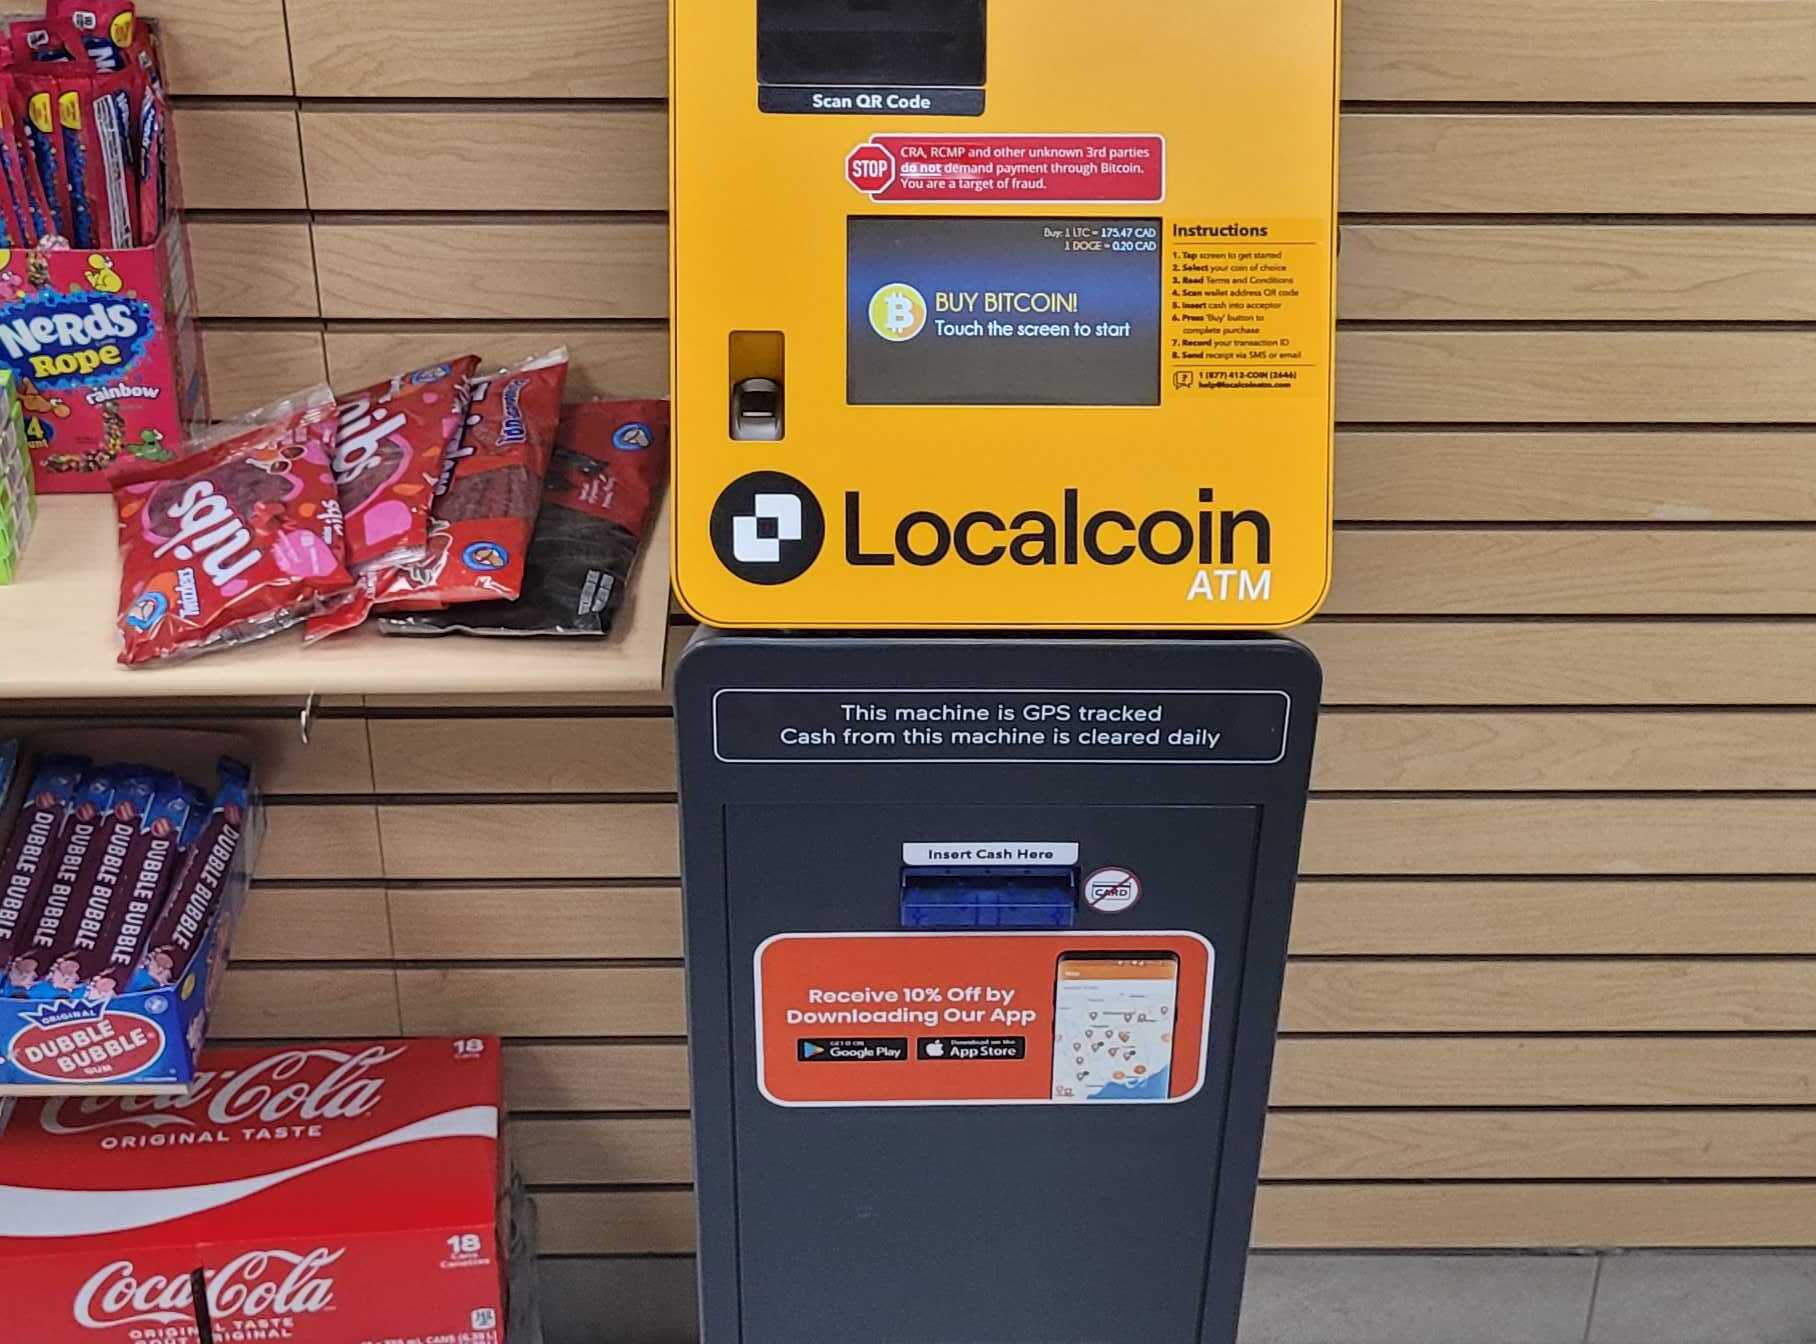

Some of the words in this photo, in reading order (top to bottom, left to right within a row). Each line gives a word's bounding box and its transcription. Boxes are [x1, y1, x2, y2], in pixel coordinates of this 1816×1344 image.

[812, 94, 852, 109] Scan
[856, 94, 883, 109] QR
[887, 95, 931, 109] Code
[900, 147, 927, 160] CRA,
[931, 147, 965, 157] RCMP
[968, 147, 991, 158] and
[994, 147, 1025, 158] other
[1029, 147, 1083, 158] unknown
[1087, 147, 1106, 158] 3rd
[1109, 147, 1149, 161] parties
[852, 160, 887, 179] STOP
[900, 163, 917, 173] do
[920, 164, 941, 173] not
[944, 163, 993, 173] demand
[996, 164, 1047, 177] payment
[1051, 163, 1098, 177] through
[1101, 163, 1144, 174] Bitcoin.
[900, 179, 923, 189] You
[927, 181, 946, 189] are
[949, 181, 956, 189] a
[959, 179, 993, 192] target
[997, 179, 1010, 189] of
[1012, 179, 1047, 189] fraud.
[1073, 229, 1090, 237] LTC
[1101, 228, 1133, 238] 175.47
[1135, 228, 1156, 238] CAD
[1173, 223, 1268, 237] Instructions
[935, 293, 978, 312] BUY
[985, 293, 1078, 313] BITCOIN!
[935, 320, 983, 336] Touch
[987, 321, 1011, 336] the
[1017, 324, 1070, 336] screen
[1074, 322, 1091, 336] to
[1095, 322, 1130, 336] start
[86, 383, 159, 404] rainbow
[153, 480, 262, 586] nibs
[845, 487, 1271, 566] Localcoin
[1186, 569, 1271, 601] ATM
[841, 705, 887, 722] This
[896, 705, 990, 722] machine
[998, 705, 1015, 722] is
[1023, 705, 1071, 722] GPS
[1079, 705, 1162, 722] tracked
[780, 728, 835, 745] Cash
[843, 728, 896, 745] from
[903, 728, 943, 745] this
[951, 728, 1045, 745] machine
[1054, 728, 1070, 745] is
[1078, 728, 1159, 745] cleared
[1168, 728, 1221, 749] daily
[96, 823, 134, 885] DUBBLE
[200, 823, 240, 888] DUBBLE
[928, 849, 972, 860] Insert
[976, 849, 1013, 859] Cash
[1017, 850, 1054, 859] Here
[1095, 889, 1128, 897] CARD
[75, 884, 112, 950] BUBBLE
[171, 882, 213, 951] BUBBLE
[809, 988, 898, 1003] Receive
[903, 987, 942, 1002] 10%
[947, 987, 981, 1001] Off
[986, 987, 1015, 1005] by
[42, 1009, 97, 1024] ORIGINAL
[787, 1008, 938, 1026] Downloading
[944, 1008, 986, 1022] Our
[990, 1008, 1036, 1026] App
[25, 1020, 115, 1063] DUBBLE
[57, 1028, 148, 1072] BUBBLE
[453, 1038, 484, 1054] 18
[830, 1047, 874, 1059] Google
[876, 1047, 901, 1058] Play
[951, 1047, 978, 1058] App
[981, 1047, 1017, 1056] Store
[101, 1131, 230, 1150] ORIGINAL
[242, 1125, 323, 1141] TASTE
[446, 1234, 481, 1253] 18
[129, 1323, 225, 1339] ORIGINL
[233, 1318, 294, 1330] TASTE
[197, 1329, 293, 1344] RIGINAL
